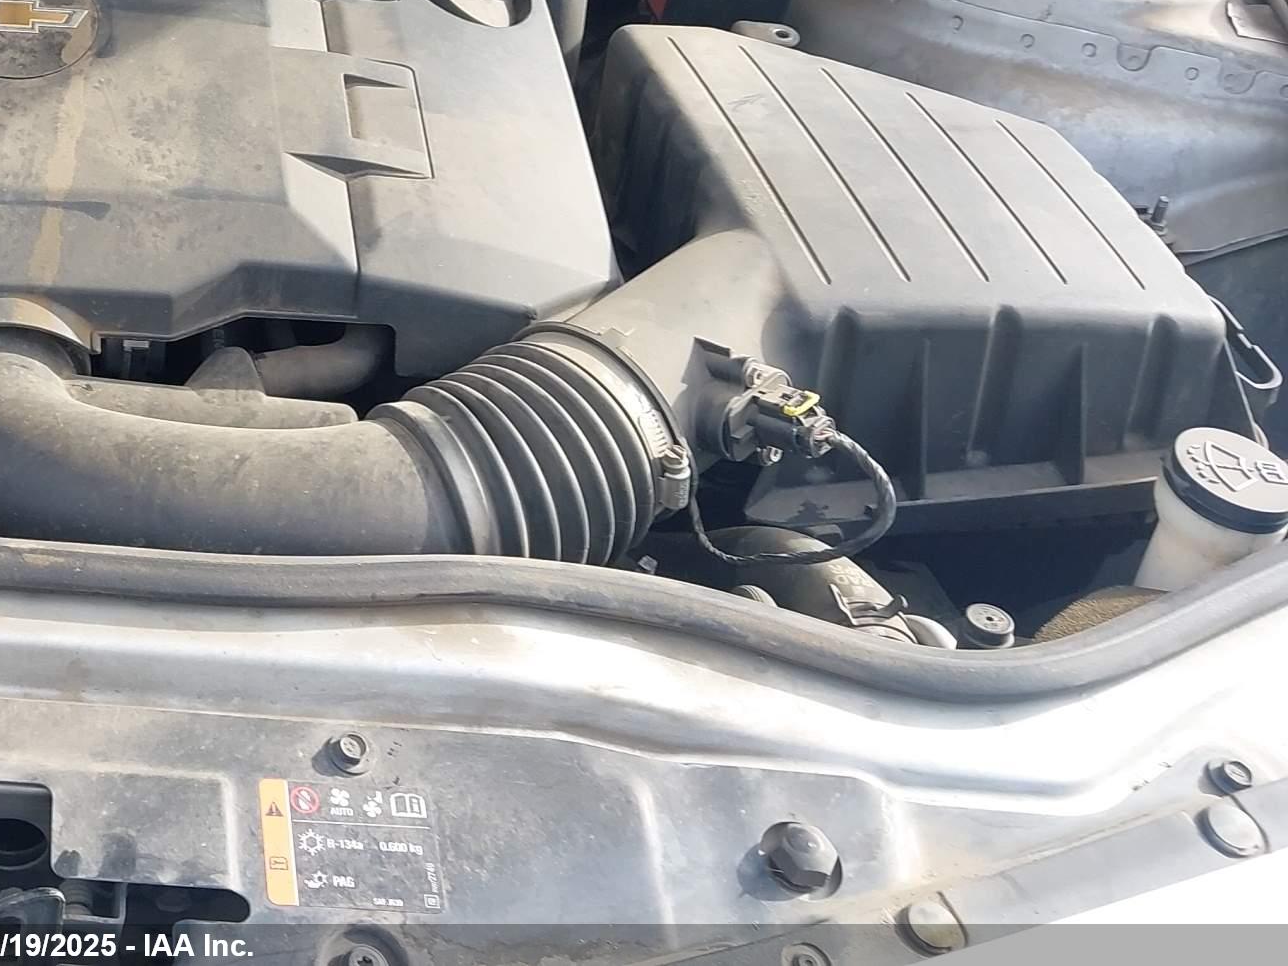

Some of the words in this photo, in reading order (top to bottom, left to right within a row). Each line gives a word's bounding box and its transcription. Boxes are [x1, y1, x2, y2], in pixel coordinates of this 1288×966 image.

[329, 807, 355, 817] AUTO
[408, 842, 424, 856] kg
[332, 875, 356, 889] PAG
